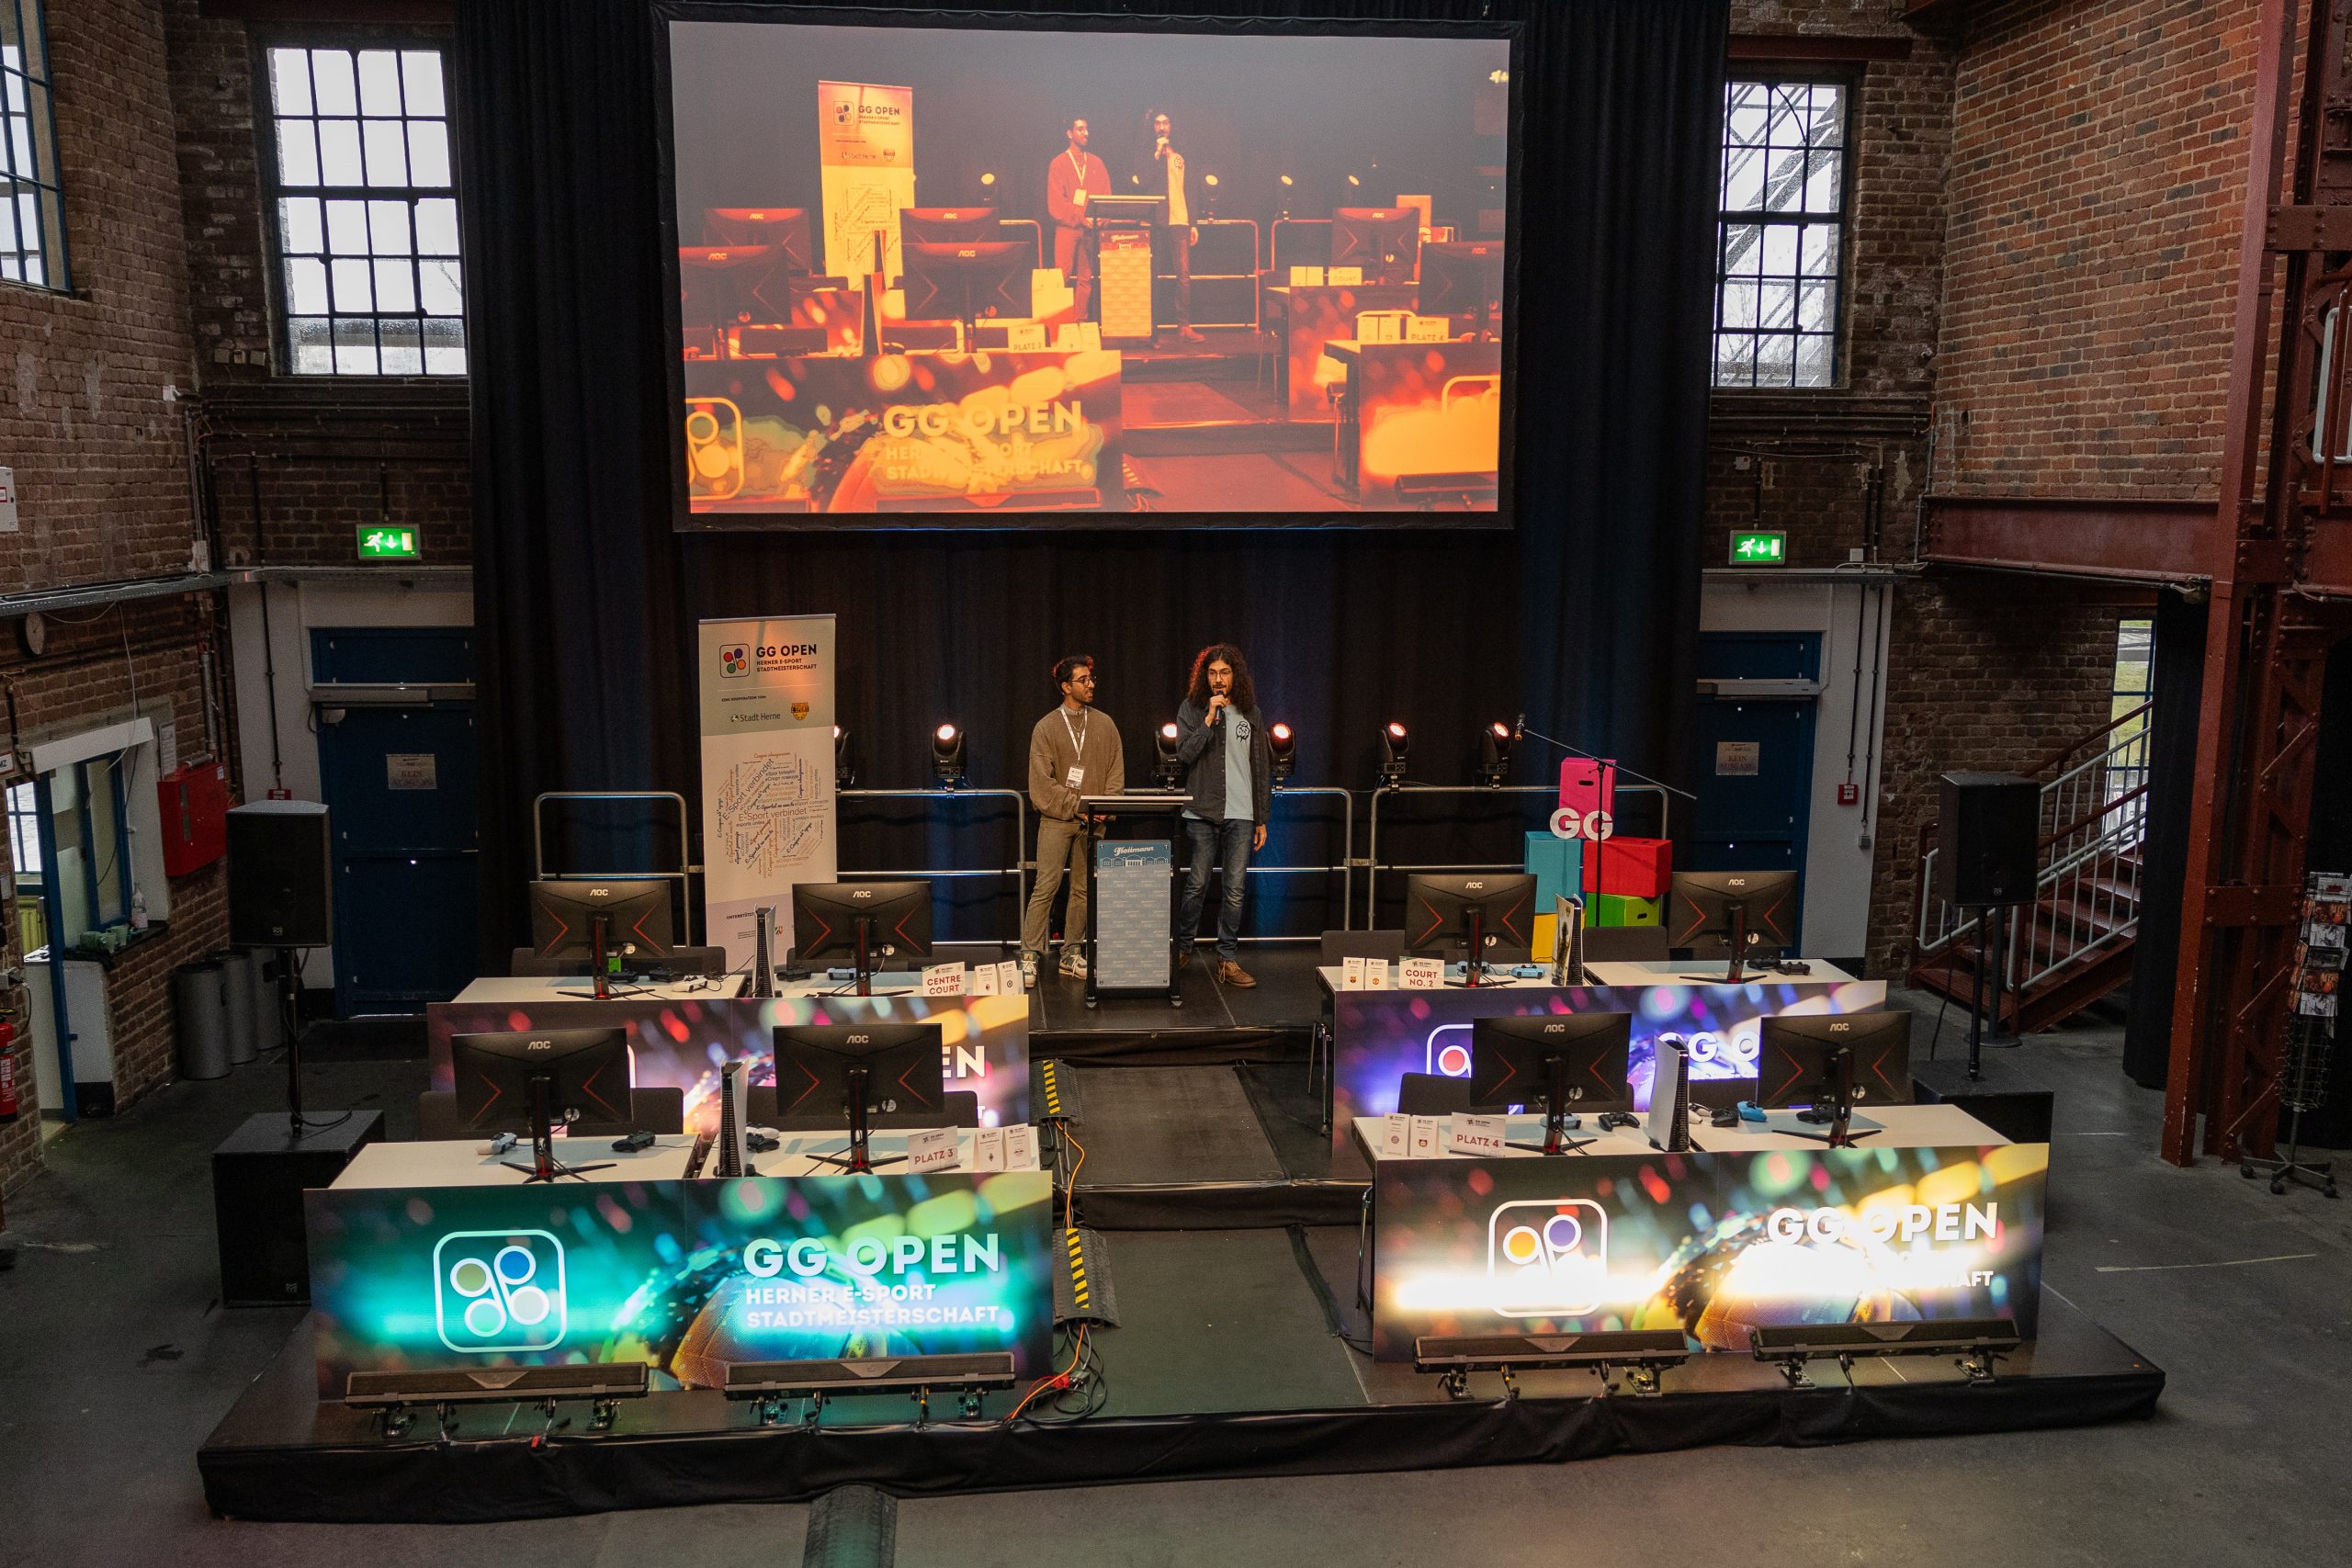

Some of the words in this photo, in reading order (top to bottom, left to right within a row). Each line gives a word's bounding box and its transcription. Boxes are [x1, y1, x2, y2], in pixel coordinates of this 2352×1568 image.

[883, 404, 950, 438] GG
[969, 400, 1081, 436] OPEN
[756, 646, 776, 658] GG
[780, 644, 817, 657] OPEN
[756, 664, 817, 672] STADTMEISTERSCHAFT
[740, 713, 760, 722] Stadt
[760, 712, 781, 721] Herne
[738, 811, 769, 822] E-Sport
[770, 807, 808, 818] verbindet
[1550, 807, 1613, 840] GG
[1465, 881, 1483, 889] AOC
[1728, 878, 1745, 886] AOC
[590, 888, 608, 897] AOC
[853, 890, 872, 898] AOC
[1405, 969, 1439, 979] COURT
[927, 975, 961, 987] CENTRE
[1409, 978, 1426, 987] NO.
[929, 984, 960, 995] COURT
[1544, 1023, 1566, 1033] AOC
[1829, 1022, 1850, 1032] AOC
[846, 1034, 869, 1044] AOC
[527, 1040, 551, 1050] AOC
[1456, 1134, 1489, 1147] PLATZ
[1492, 1139, 1499, 1148] 4
[914, 1149, 945, 1165] PLATZ
[947, 1148, 954, 1157] 3
[1768, 1206, 1845, 1246] GG
[1860, 1201, 1998, 1244] OPEN
[743, 1237, 827, 1278] GG
[846, 1234, 1000, 1276] OPEN
[746, 1285, 836, 1304] HERNER
[842, 1283, 936, 1303] E-SPORT
[746, 1305, 1000, 1328] STADTMEISTERSCHAFT
